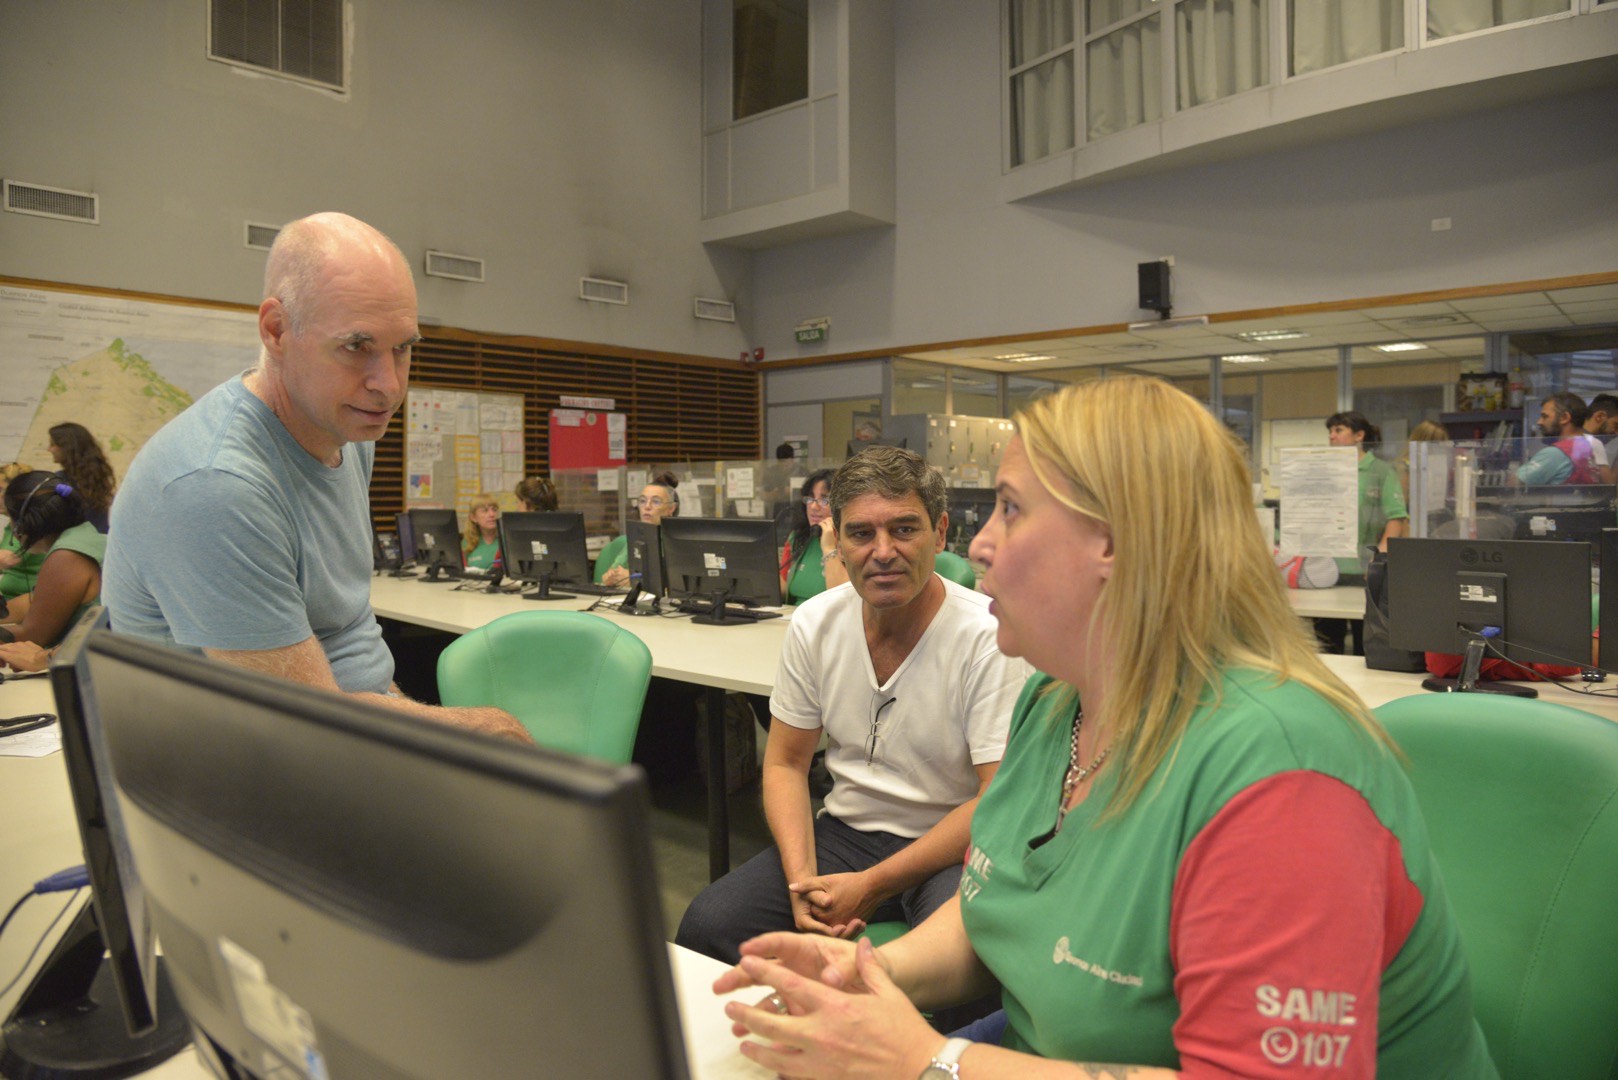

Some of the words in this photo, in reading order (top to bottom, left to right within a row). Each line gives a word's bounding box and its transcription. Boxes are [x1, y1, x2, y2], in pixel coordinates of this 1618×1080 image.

[798, 329, 820, 341] SALIDA
[1482, 551, 1503, 563] LG
[1255, 983, 1357, 1026] SAME
[1301, 1031, 1352, 1068] 107
